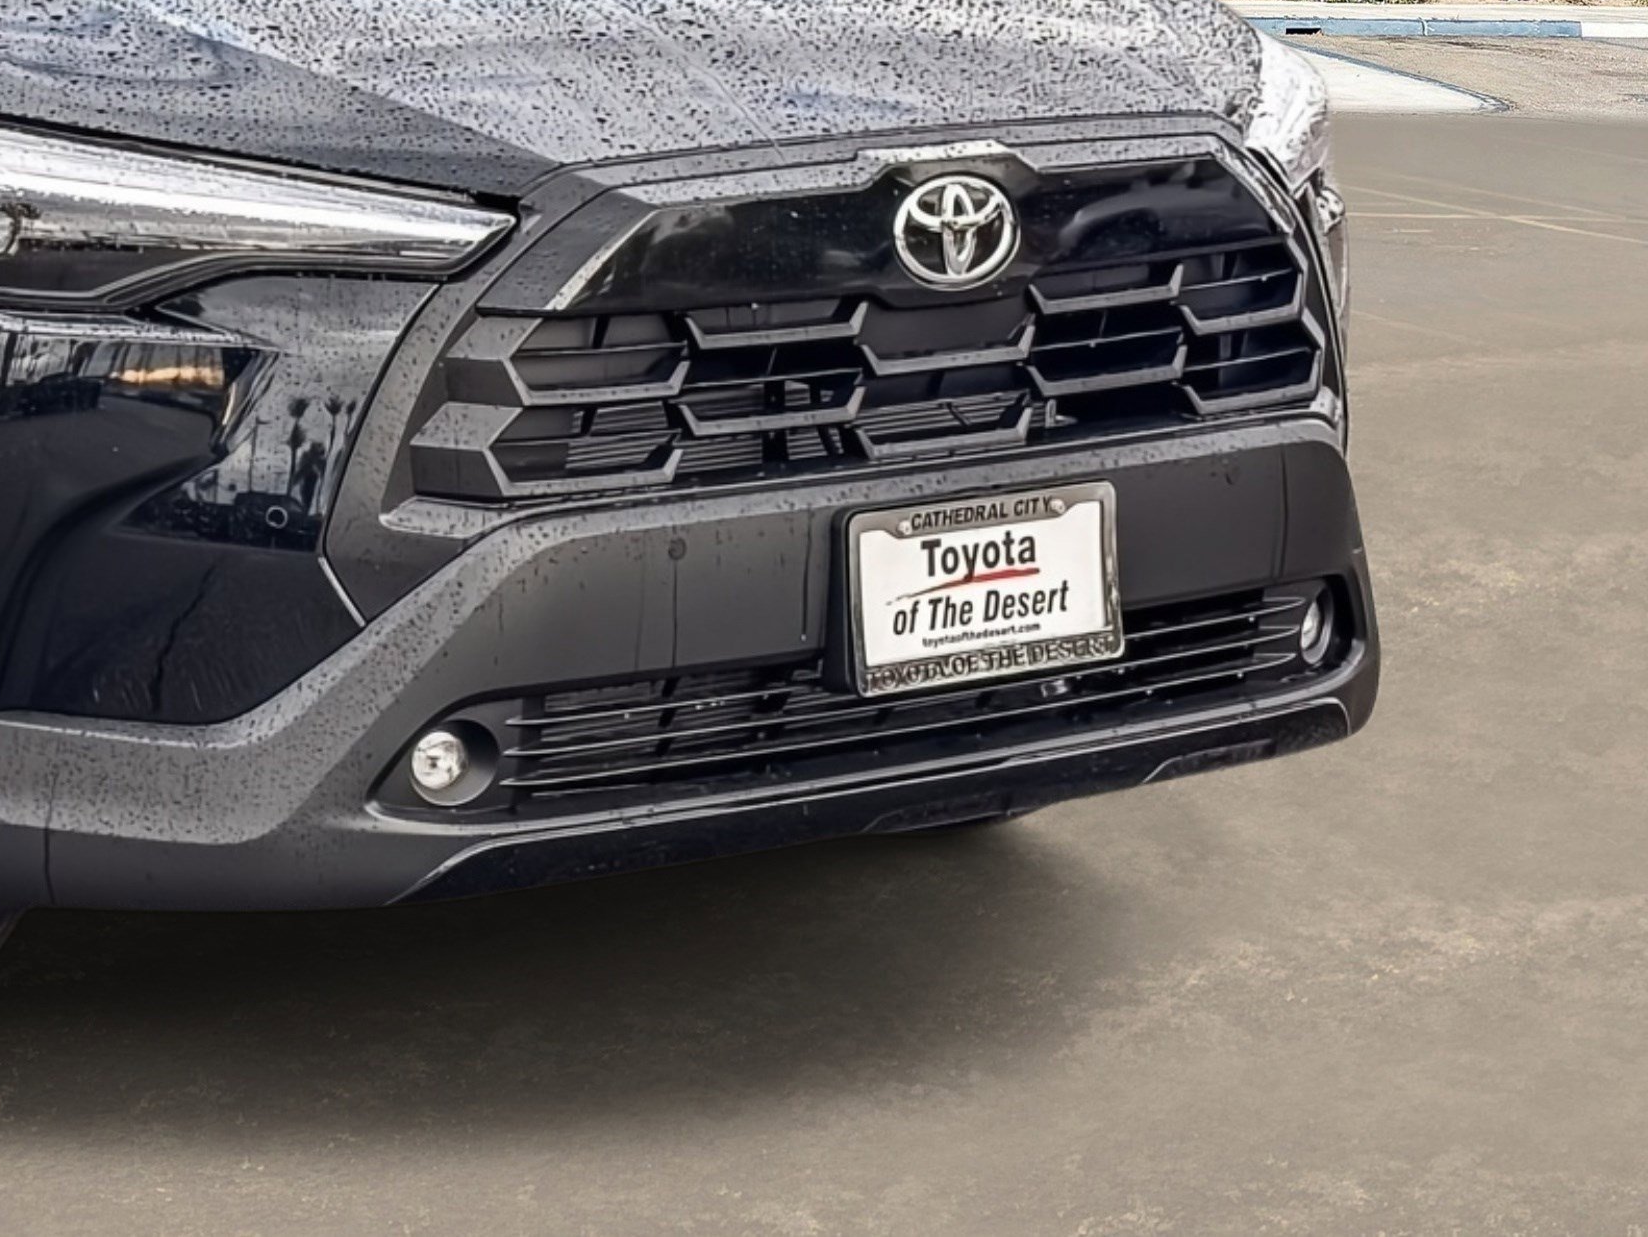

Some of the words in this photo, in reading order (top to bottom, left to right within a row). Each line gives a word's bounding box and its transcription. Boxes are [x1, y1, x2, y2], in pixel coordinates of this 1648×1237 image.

[911, 502, 1008, 530] CATHEDRAL
[1014, 497, 1052, 516] CITY
[921, 531, 1036, 581] Toyota
[892, 600, 921, 635] of
[928, 593, 974, 631] The
[983, 580, 1070, 622] Desert
[951, 653, 979, 675] OF
[982, 644, 1027, 670] THE
